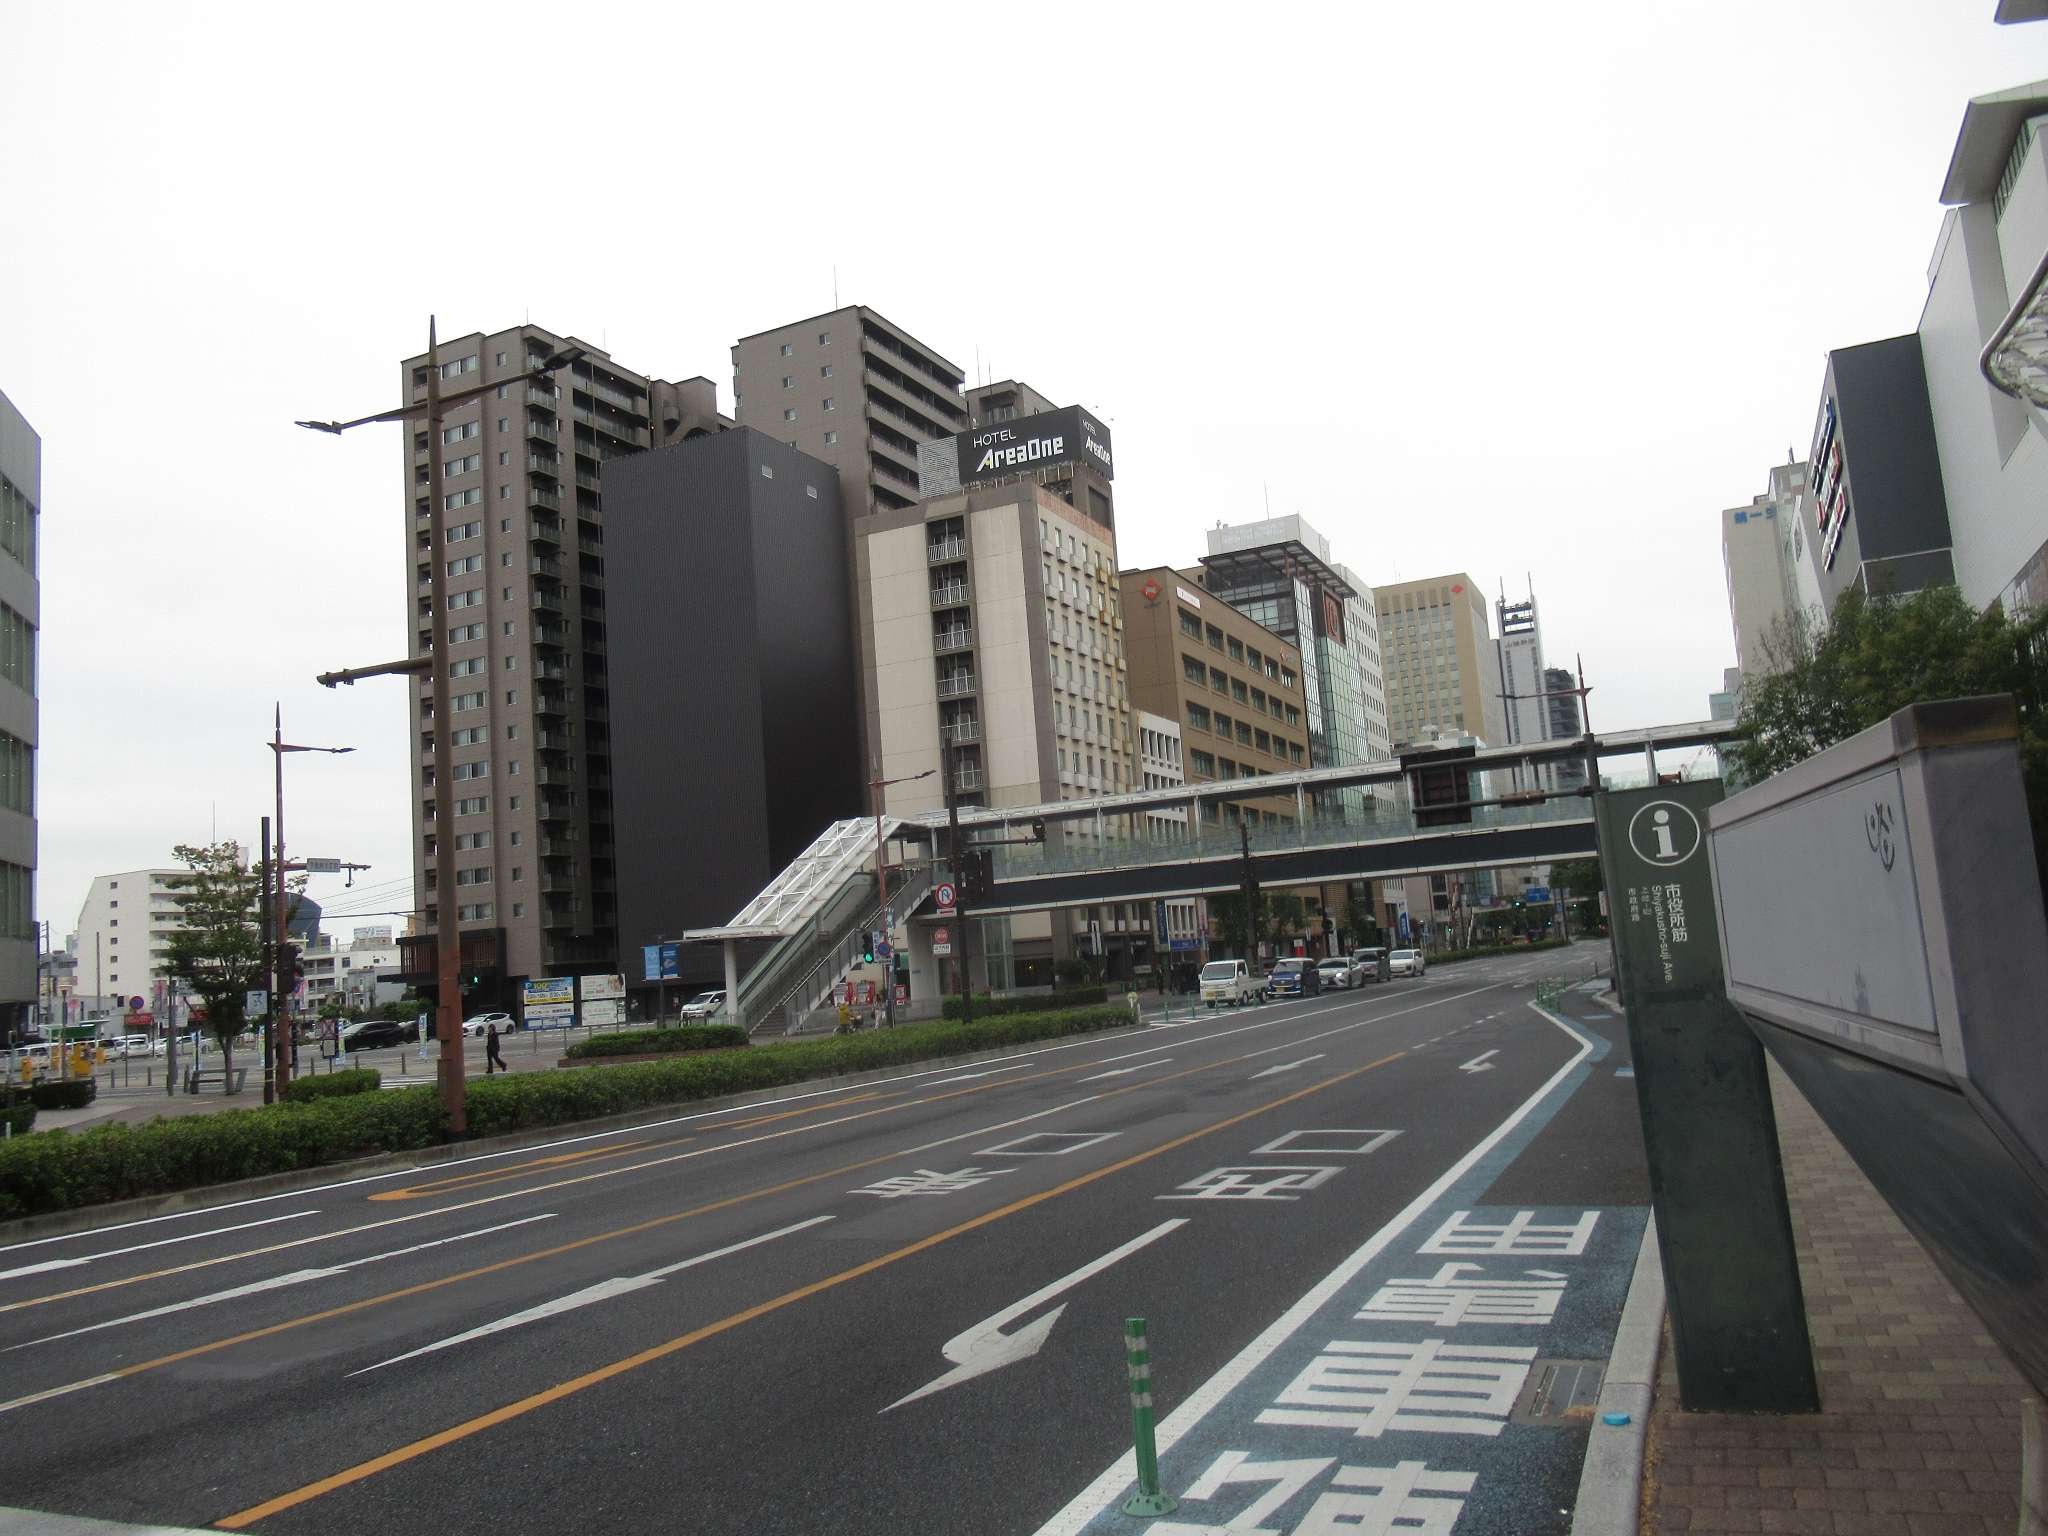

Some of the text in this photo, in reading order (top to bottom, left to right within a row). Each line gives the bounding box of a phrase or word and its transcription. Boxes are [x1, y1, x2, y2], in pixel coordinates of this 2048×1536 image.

[973, 428, 1017, 448] HOTEL
[976, 436, 1064, 472] AreaOne
[1652, 885, 1673, 985] Shiyakusho-suji Ave.
[1665, 883, 1688, 943] 市役所筋
